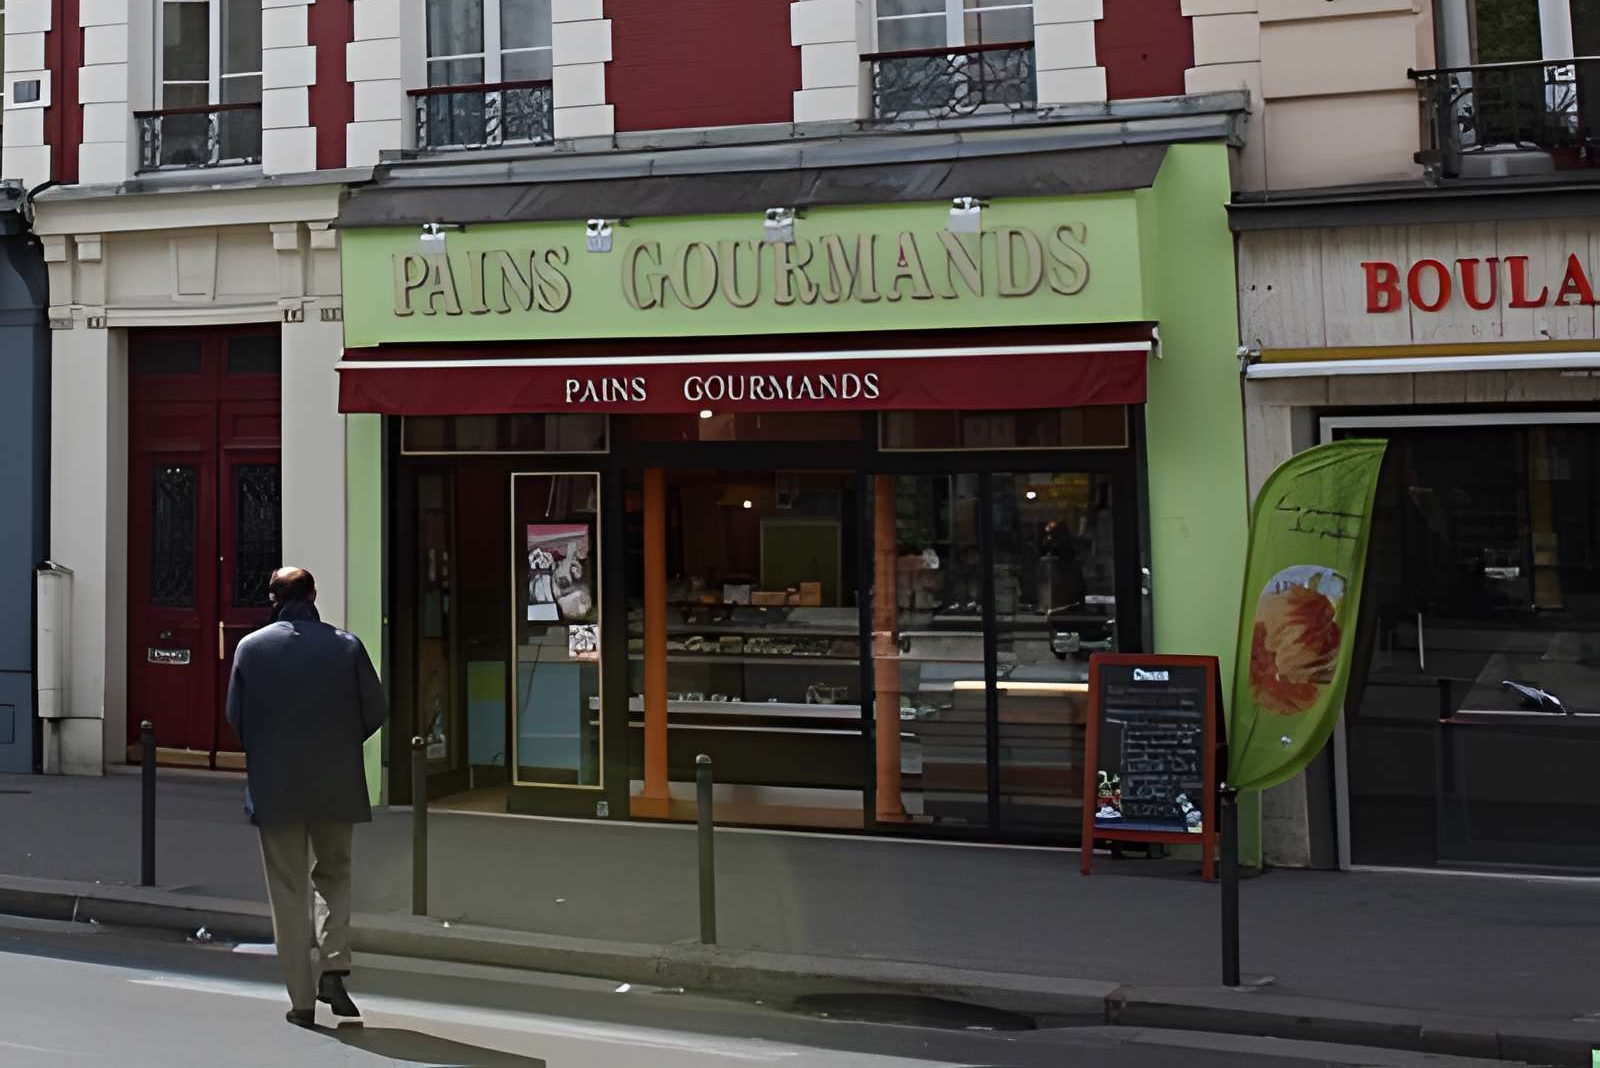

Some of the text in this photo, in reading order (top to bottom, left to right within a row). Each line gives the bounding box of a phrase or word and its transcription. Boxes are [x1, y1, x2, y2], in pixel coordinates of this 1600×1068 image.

[391, 223, 1091, 317] PAINS GOURMANDS
[565, 372, 880, 403] PAINS GOURMANDS
